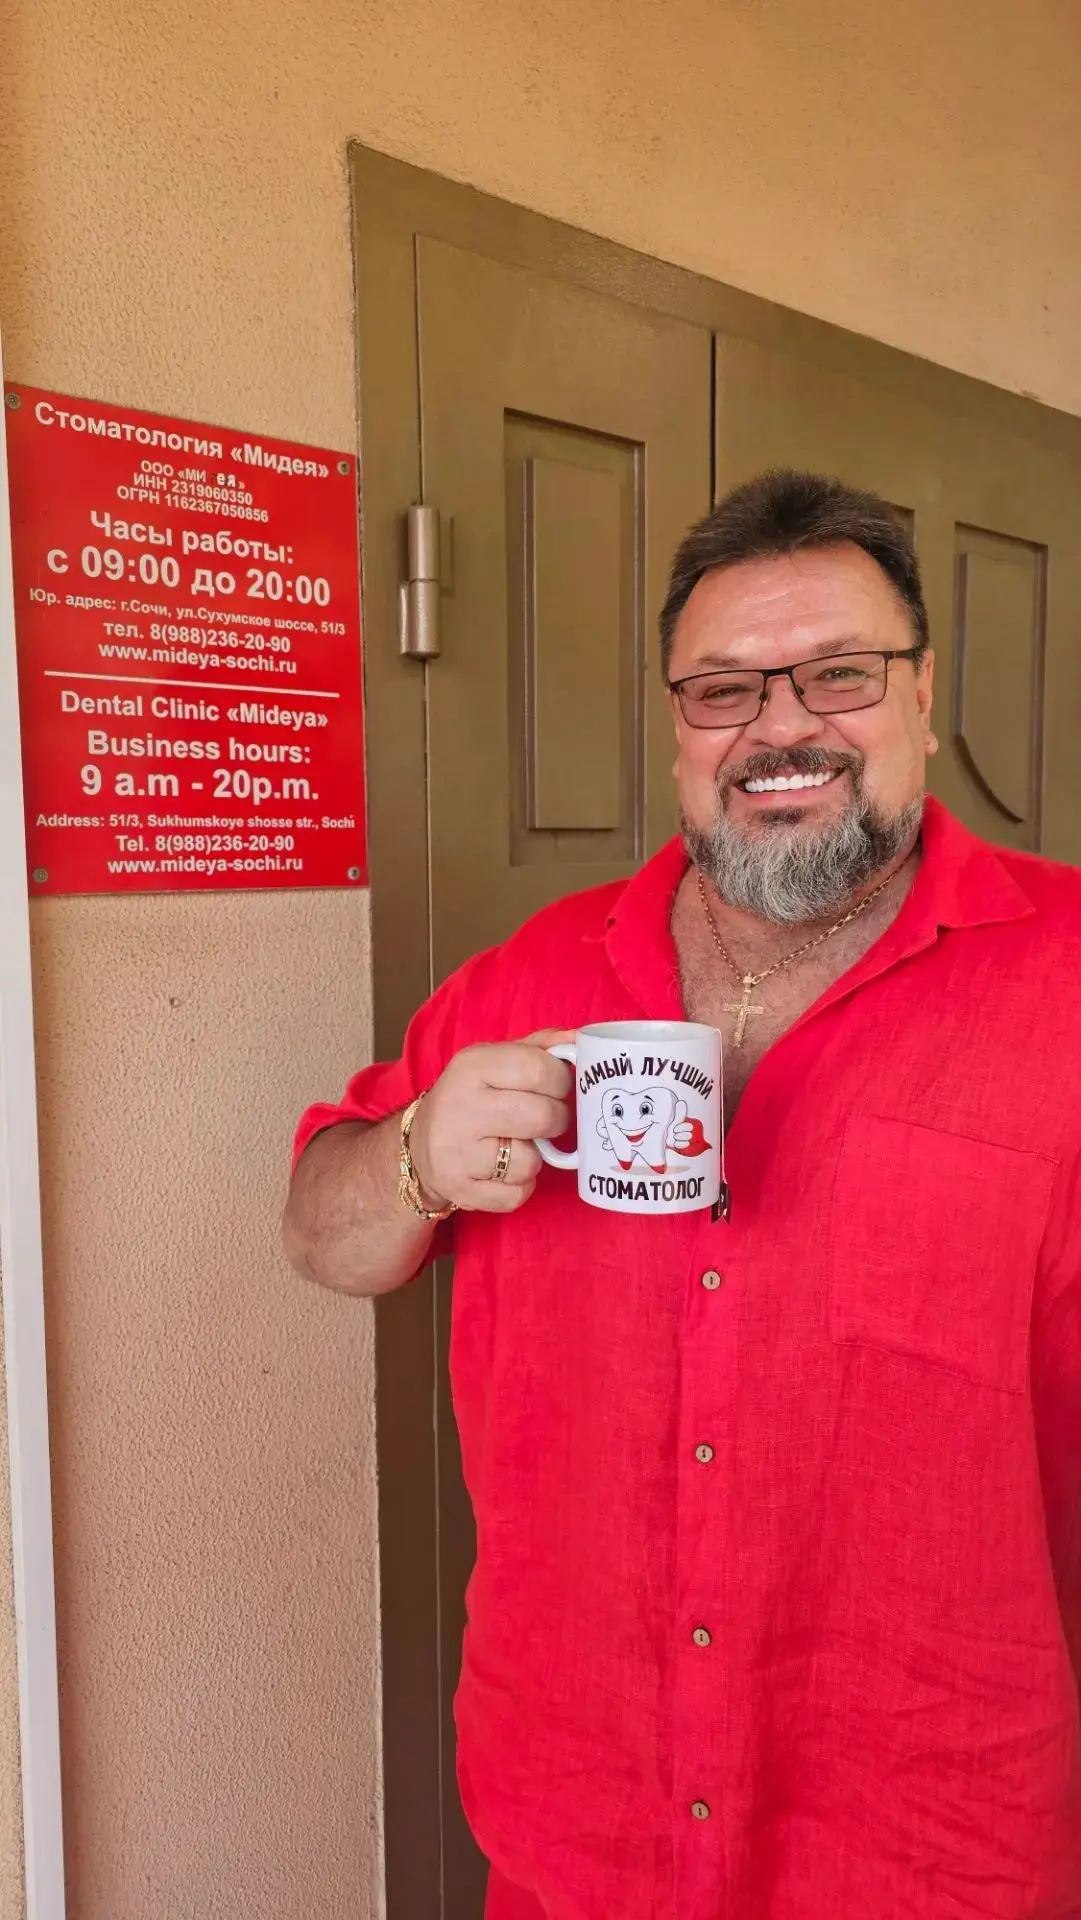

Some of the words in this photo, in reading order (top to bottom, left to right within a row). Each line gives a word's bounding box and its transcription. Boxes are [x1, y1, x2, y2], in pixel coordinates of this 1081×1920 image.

[34, 402, 223, 459] Стоматология
[231, 444, 329, 479] «Мидея»
[141, 460, 173, 476] ООО
[117, 486, 160, 504] ОГРН
[165, 494, 268, 522] 1162367050856
[134, 473, 167, 490] ИНН
[171, 479, 253, 505] 2319060350
[90, 510, 172, 546] Часы
[182, 530, 293, 564] работы:
[82, 546, 180, 587] 09:00
[191, 568, 235, 597] до
[246, 569, 330, 606] 20:00
[29, 588, 60, 605] Юр.
[66, 594, 116, 610] адрес:
[121, 599, 171, 618] г.Сочи,
[176, 607, 271, 627] ул.Сухумское
[274, 618, 318, 634] шоссе,
[321, 622, 346, 635] 51/3
[103, 622, 144, 639] тел.
[150, 624, 291, 653] 8(988)236-20-90
[98, 644, 296, 673] www.mideya-sochi.ru
[61, 690, 143, 717] Dental
[151, 696, 219, 721] Clinic
[227, 703, 328, 732] «Mideya»
[88, 730, 220, 760] Business
[229, 737, 311, 763] hours:
[80, 765, 102, 795] 9
[115, 773, 179, 797] a.m
[213, 769, 319, 805] 20p.m.
[36, 813, 105, 827] Address:
[110, 814, 143, 829] 51/3,
[148, 814, 244, 830] Sukhumskoye
[247, 816, 292, 828] shosse
[296, 817, 319, 830] str.,
[321, 815, 355, 828] Sochi
[116, 835, 148, 851] Tel.
[155, 835, 294, 854] 8(988)236-20-90
[107, 857, 303, 876] www.mideya-sochi.ru
[579, 1053, 633, 1095] САМЫЙ
[641, 1057, 714, 1100] ЛУЧШИЙ
[589, 1174, 704, 1201] СТОМАТОЛОГ
